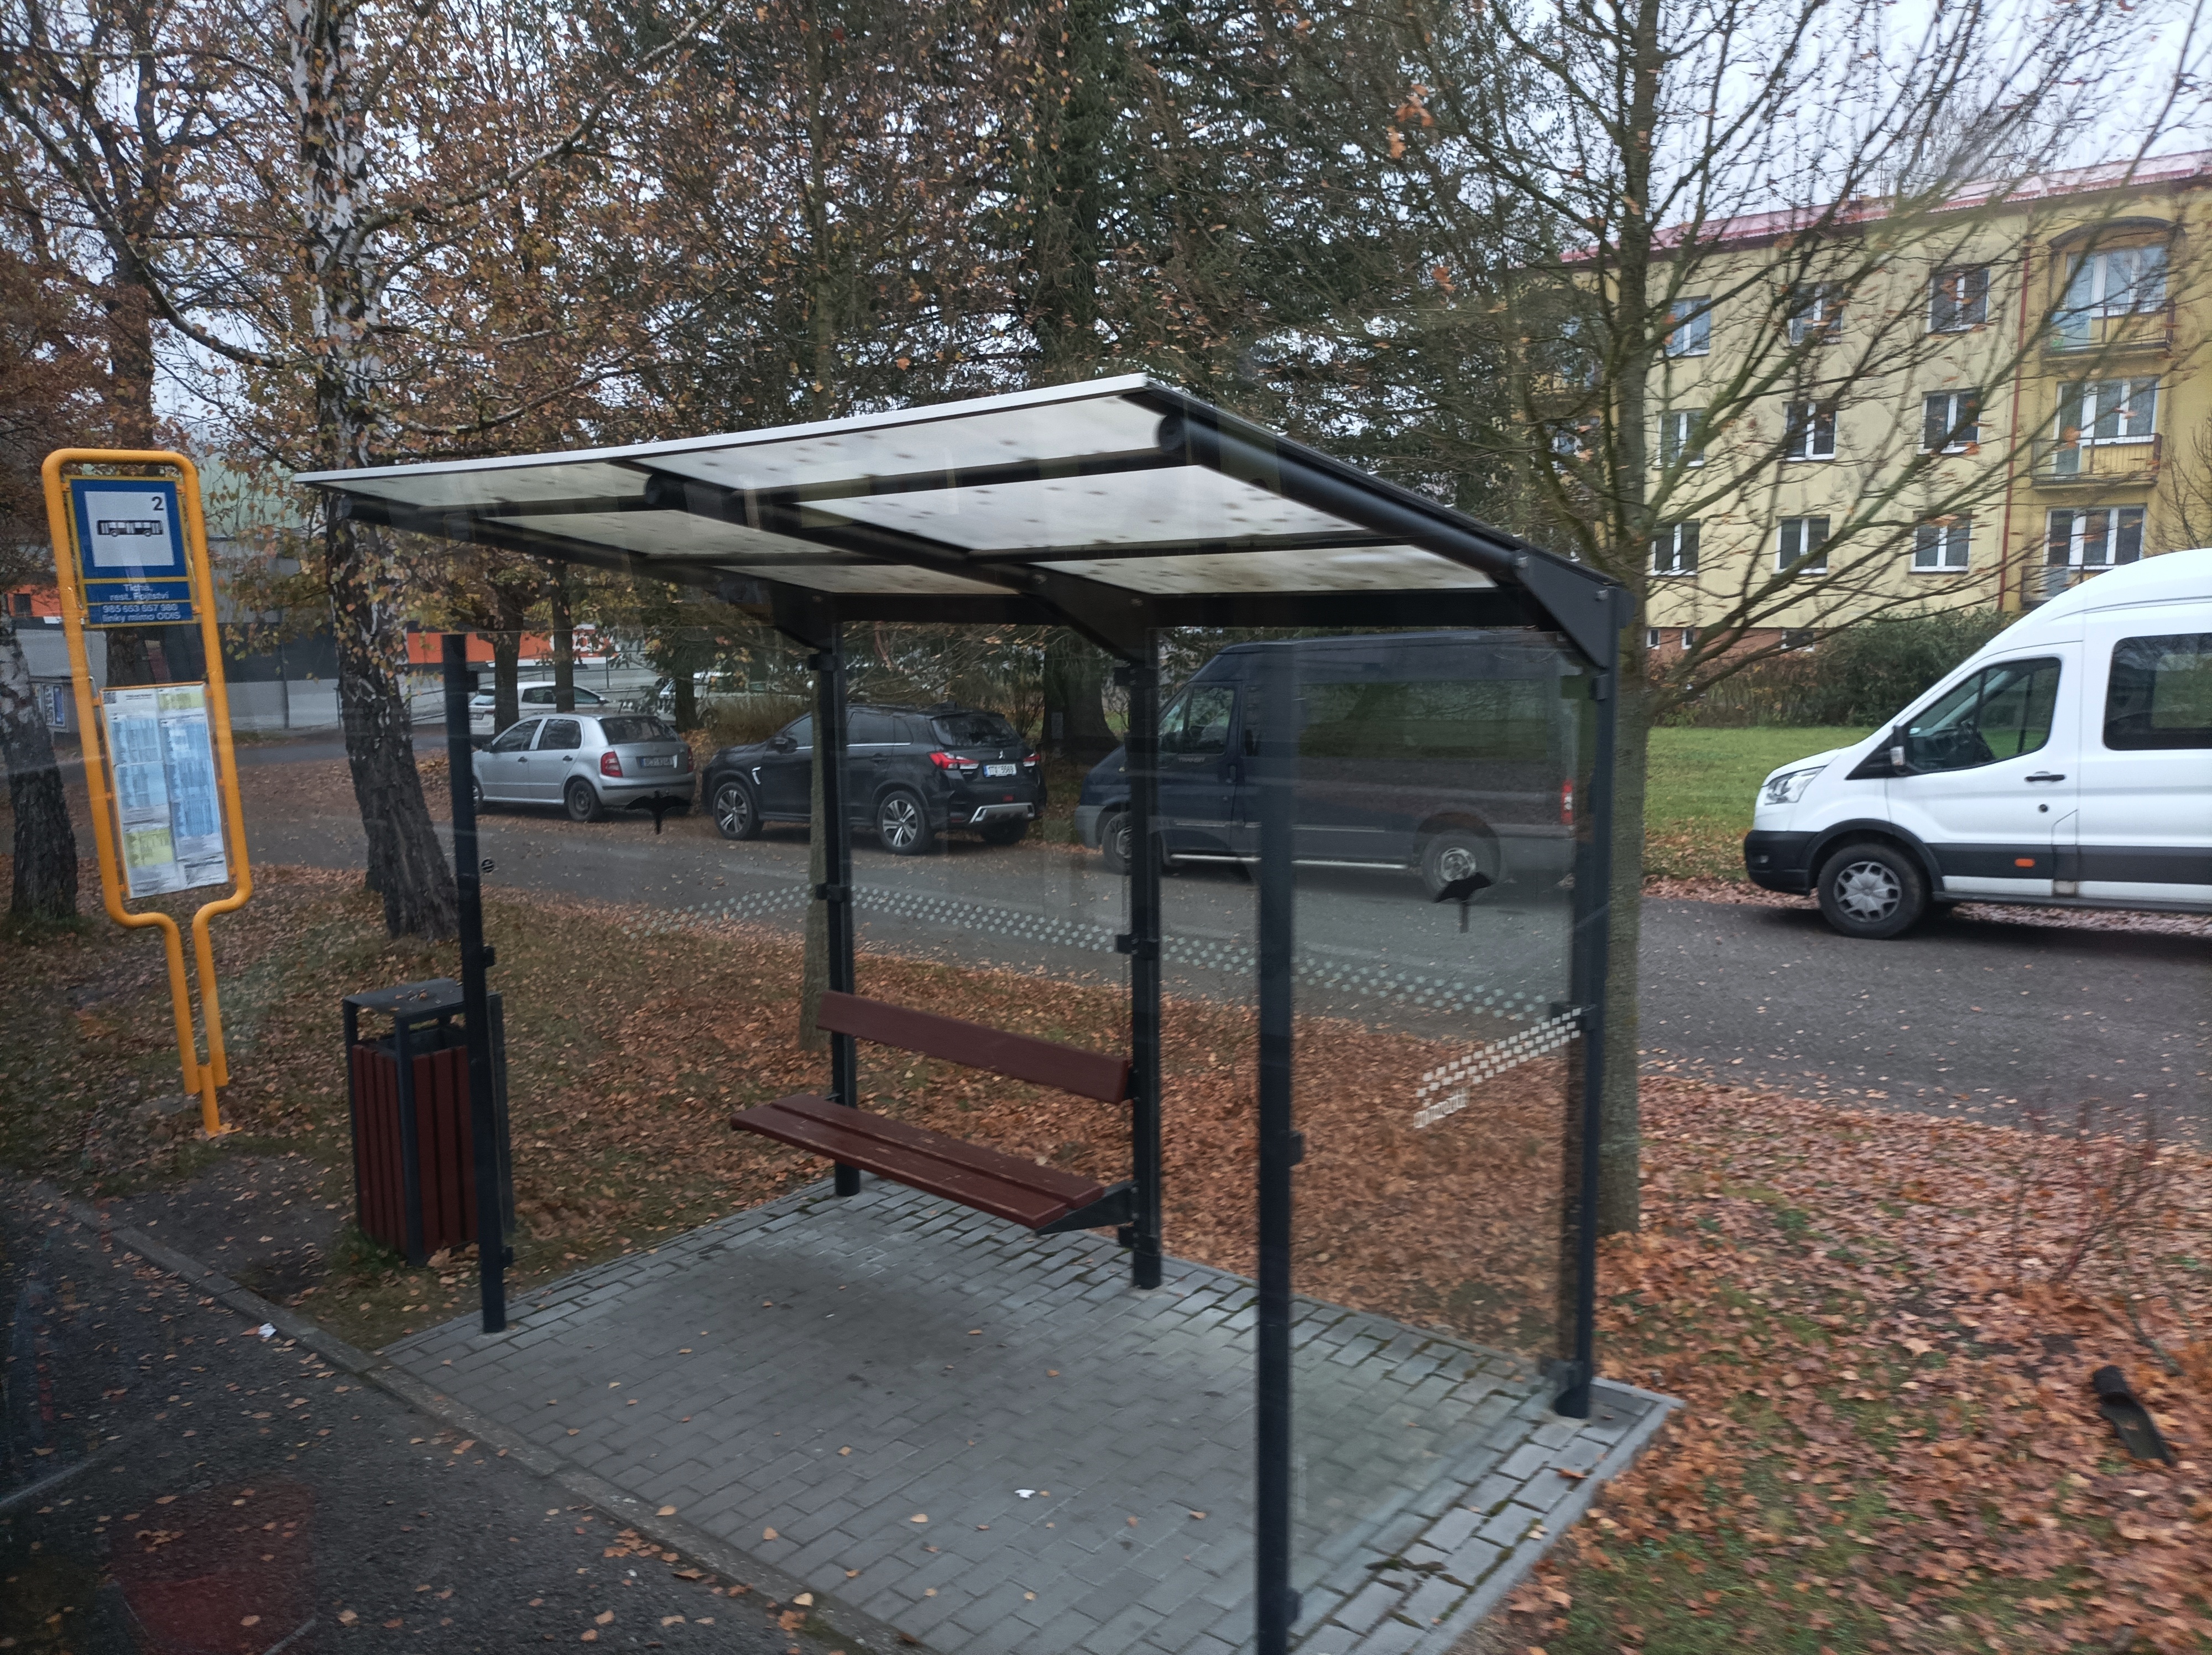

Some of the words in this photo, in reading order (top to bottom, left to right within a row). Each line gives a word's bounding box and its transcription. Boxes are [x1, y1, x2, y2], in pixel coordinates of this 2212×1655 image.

[152, 496, 164, 511] 2
[102, 613, 126, 623] linky
[156, 611, 181, 620] ODIS
